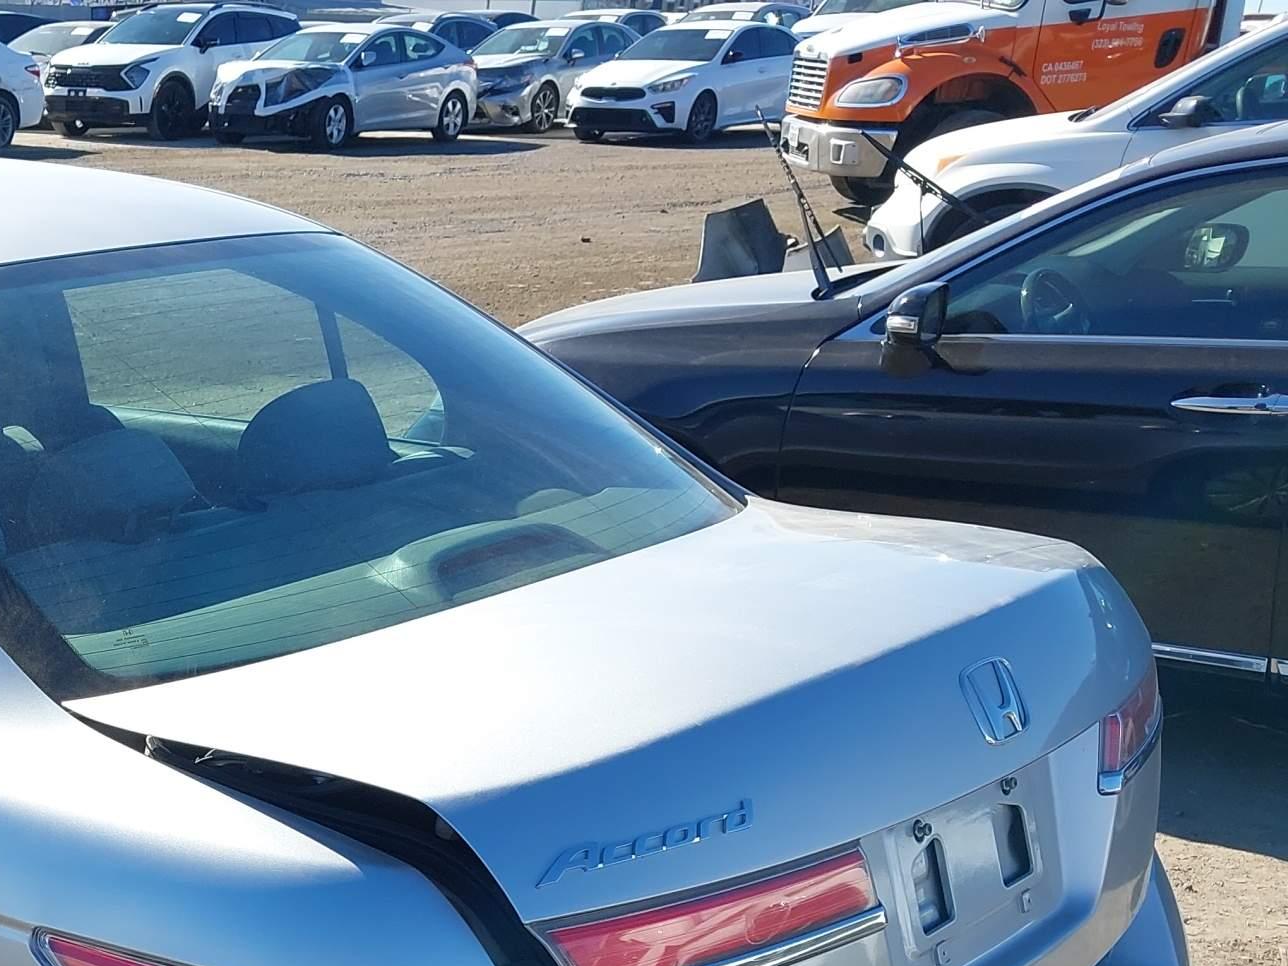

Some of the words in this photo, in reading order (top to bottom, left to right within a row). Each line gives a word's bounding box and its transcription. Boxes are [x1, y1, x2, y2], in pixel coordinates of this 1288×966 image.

[1097, 21, 1118, 32] Loyal
[1119, 21, 1145, 34] Towing
[1042, 63, 1053, 73] CA
[1040, 74, 1057, 85] DOT
[534, 798, 753, 889] Accord
